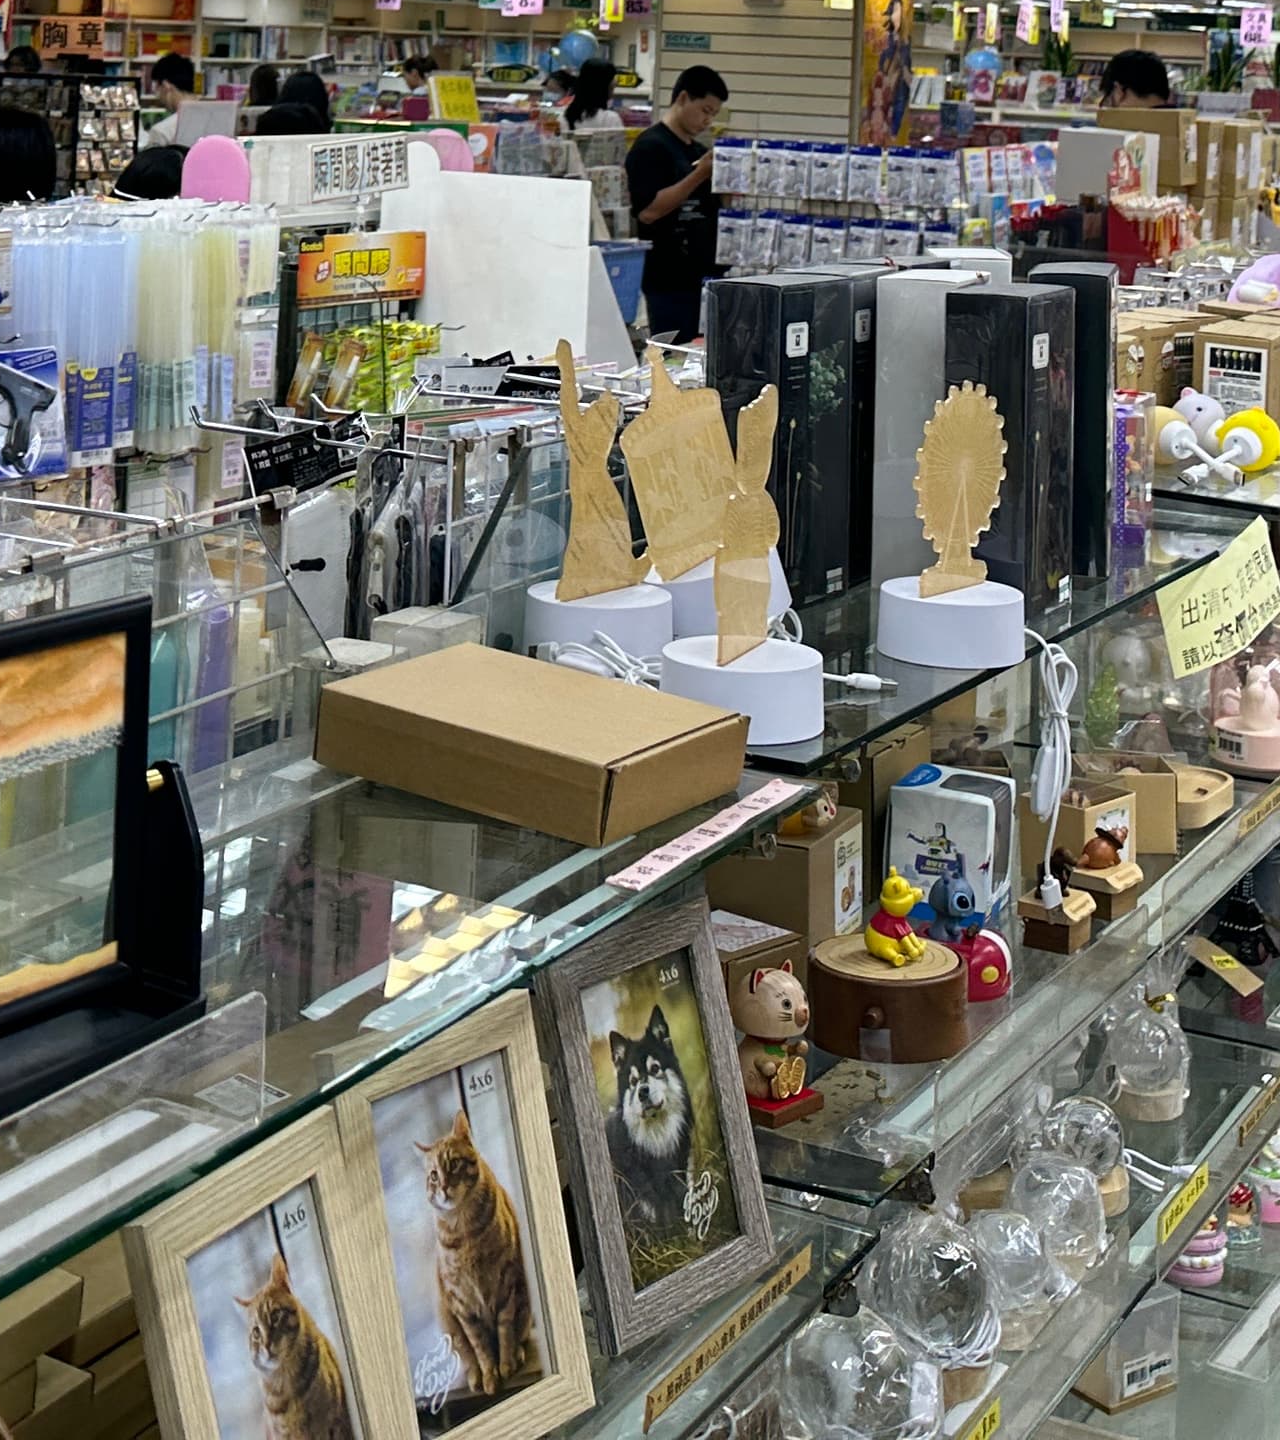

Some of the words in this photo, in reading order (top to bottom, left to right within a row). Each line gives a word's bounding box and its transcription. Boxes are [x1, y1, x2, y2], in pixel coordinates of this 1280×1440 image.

[42, 22, 102, 48] 胸章
[334, 249, 391, 278] 瞬間膠
[658, 964, 679, 984] 4x6
[469, 1069, 493, 1091] 4x6
[282, 1203, 306, 1229] 4x6
